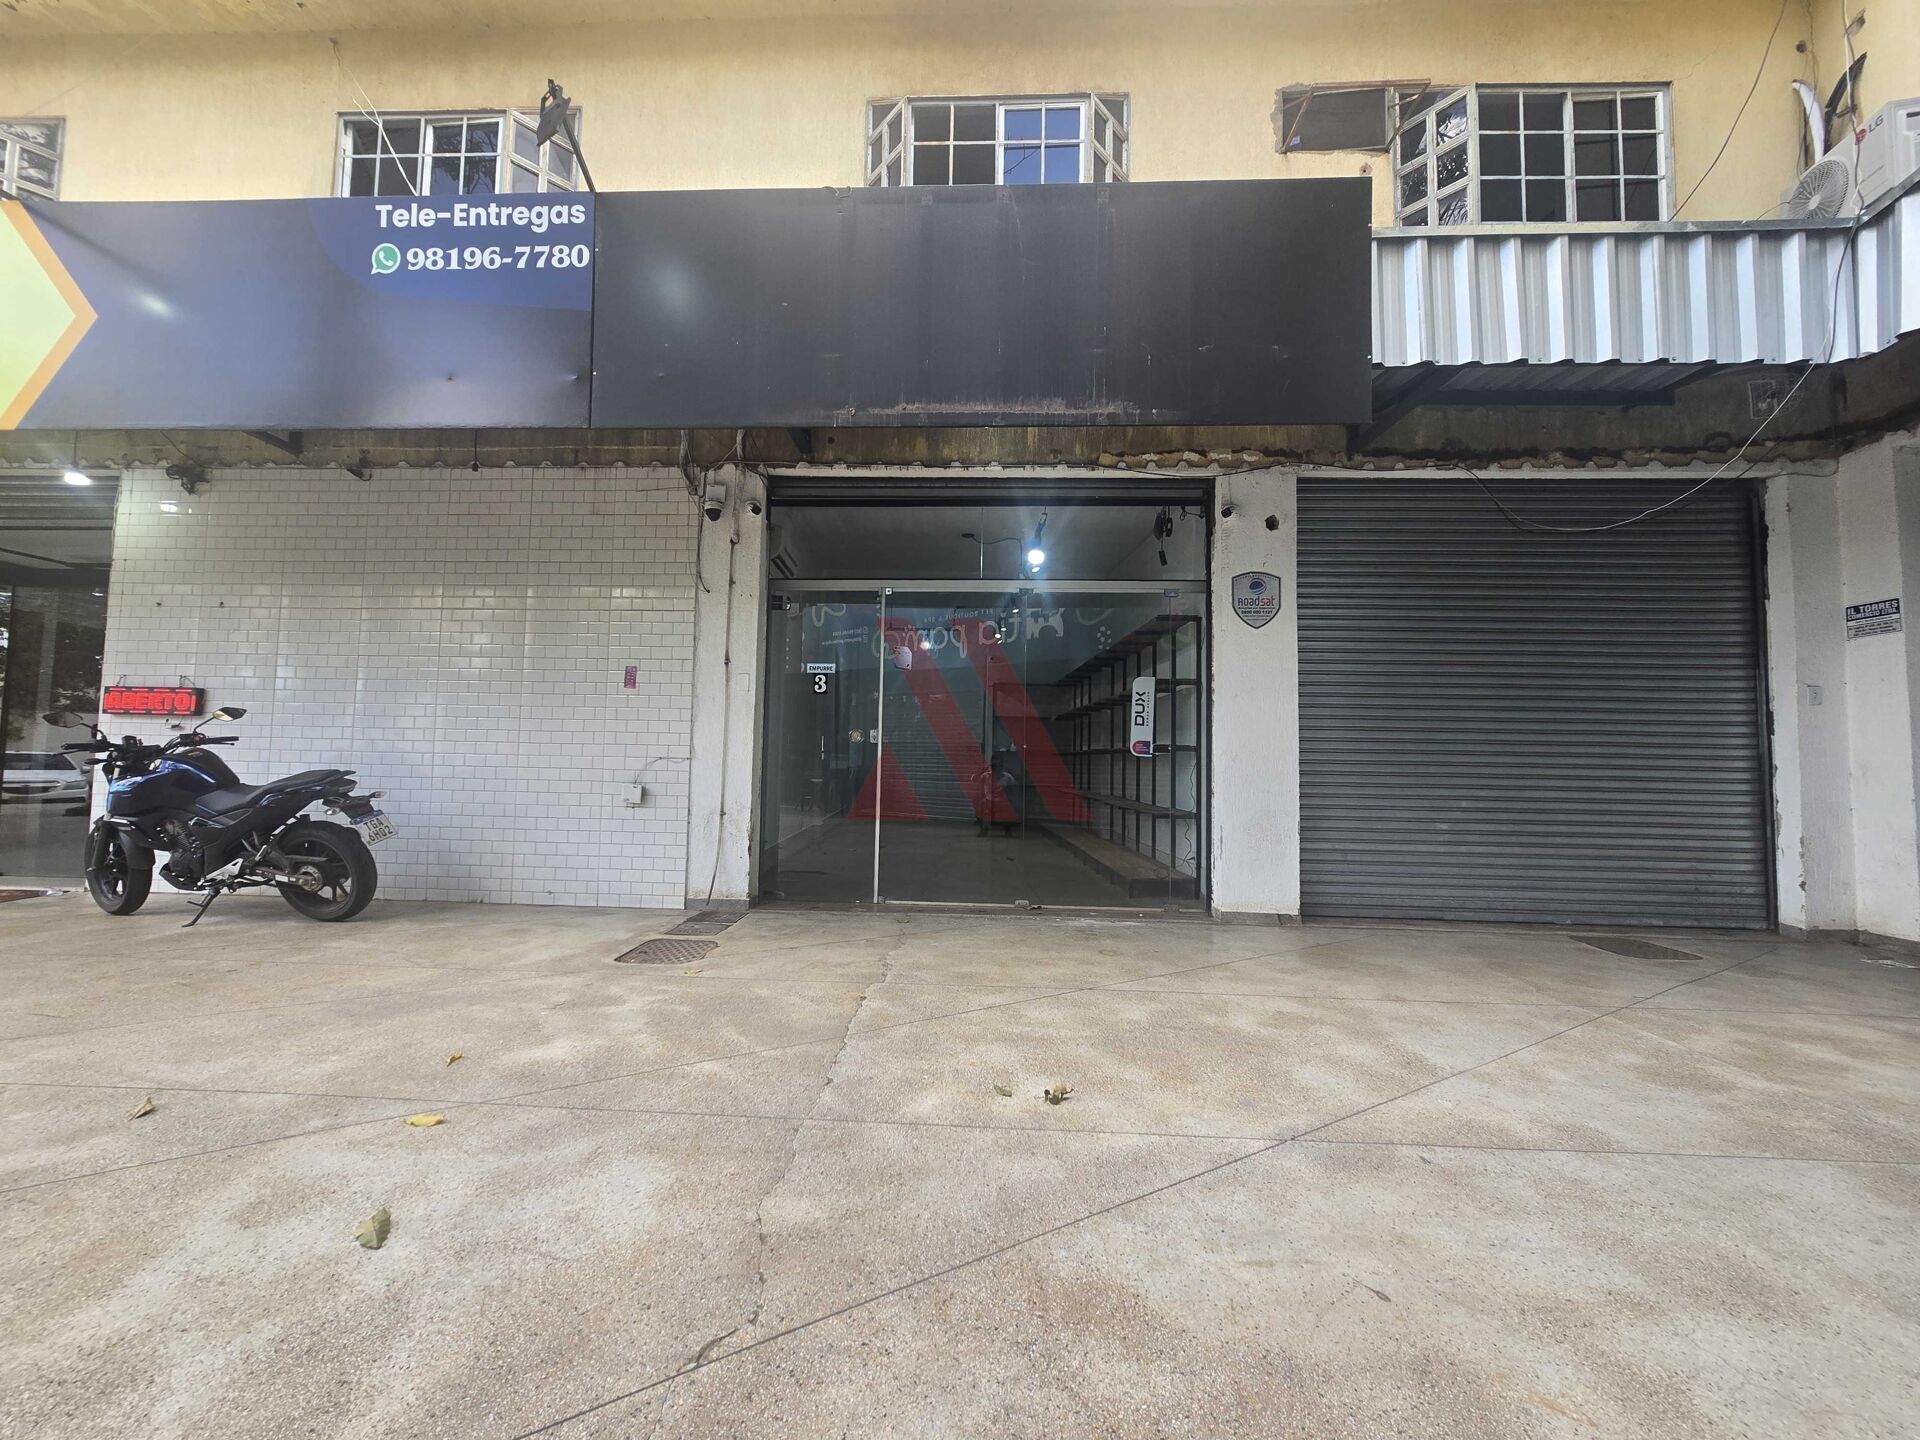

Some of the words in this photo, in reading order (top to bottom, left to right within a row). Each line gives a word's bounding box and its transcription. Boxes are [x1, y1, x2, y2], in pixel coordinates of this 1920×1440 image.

[1868, 114, 1884, 133] LG
[375, 202, 586, 233] Tele-Entregas
[406, 244, 590, 270] 98196-7780
[1859, 600, 1898, 613] TORRES
[814, 674, 827, 693] 3
[108, 691, 191, 710] ABERTO
[1135, 692, 1146, 726] DUX
[363, 817, 384, 831] TGA
[368, 825, 393, 842] 6H02
